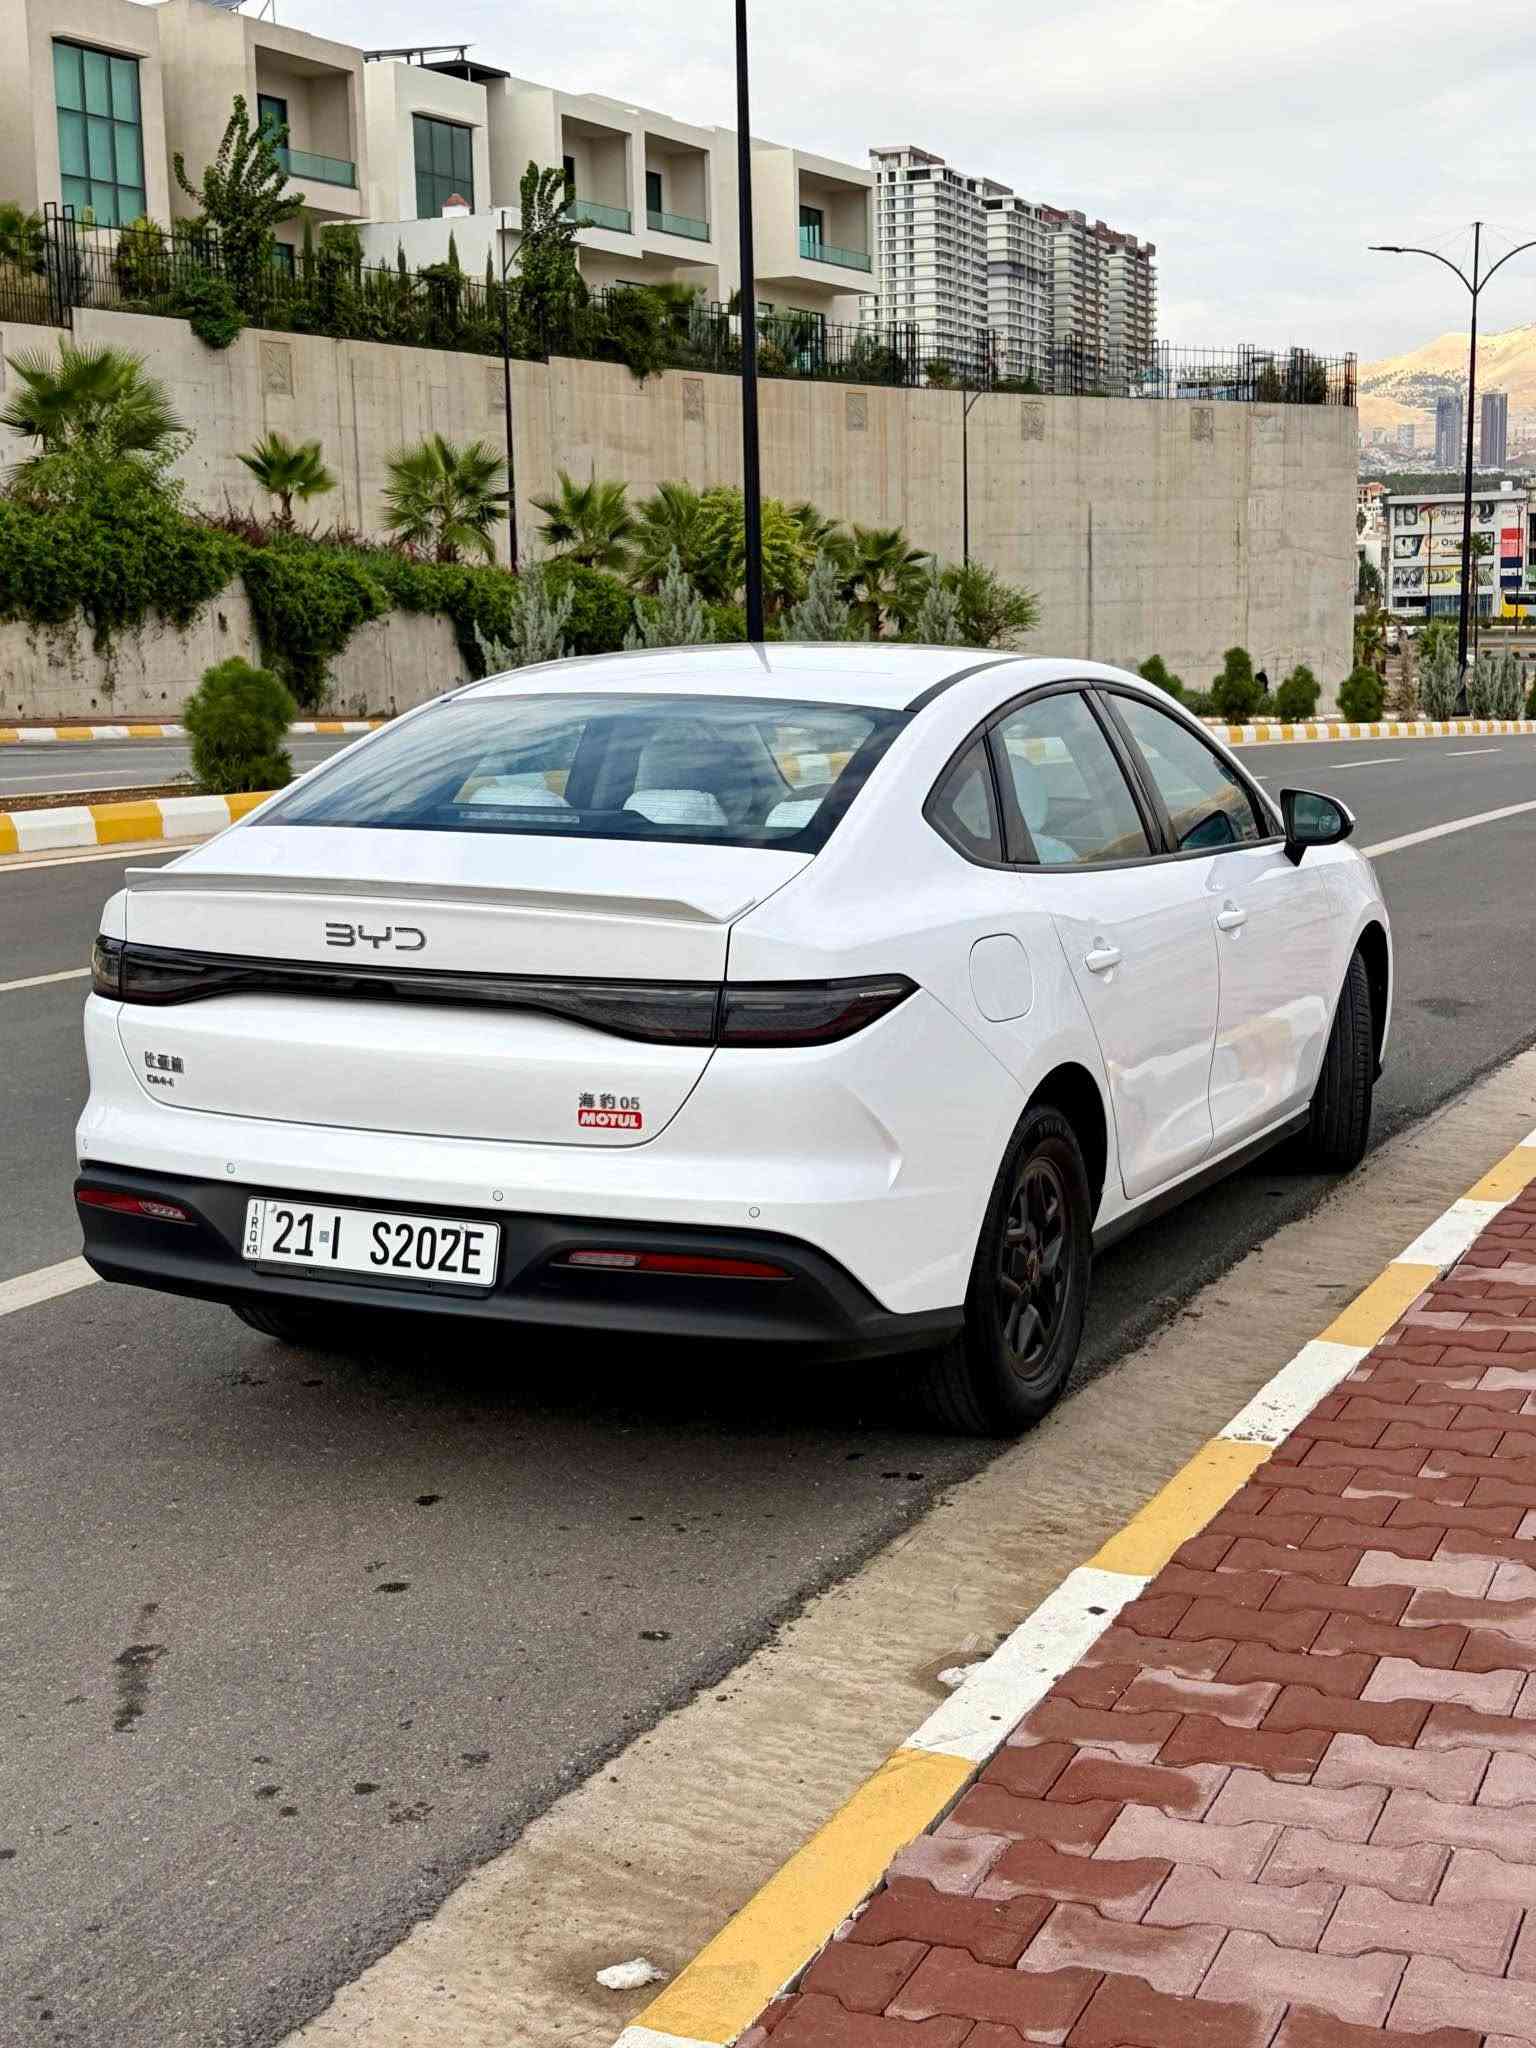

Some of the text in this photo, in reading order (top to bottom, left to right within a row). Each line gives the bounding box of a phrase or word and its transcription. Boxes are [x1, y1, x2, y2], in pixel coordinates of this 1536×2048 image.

[326, 922, 426, 950] BYD
[620, 1096, 640, 1110] 05
[580, 1111, 639, 1127] MOTUL
[272, 1210, 314, 1257] 21
